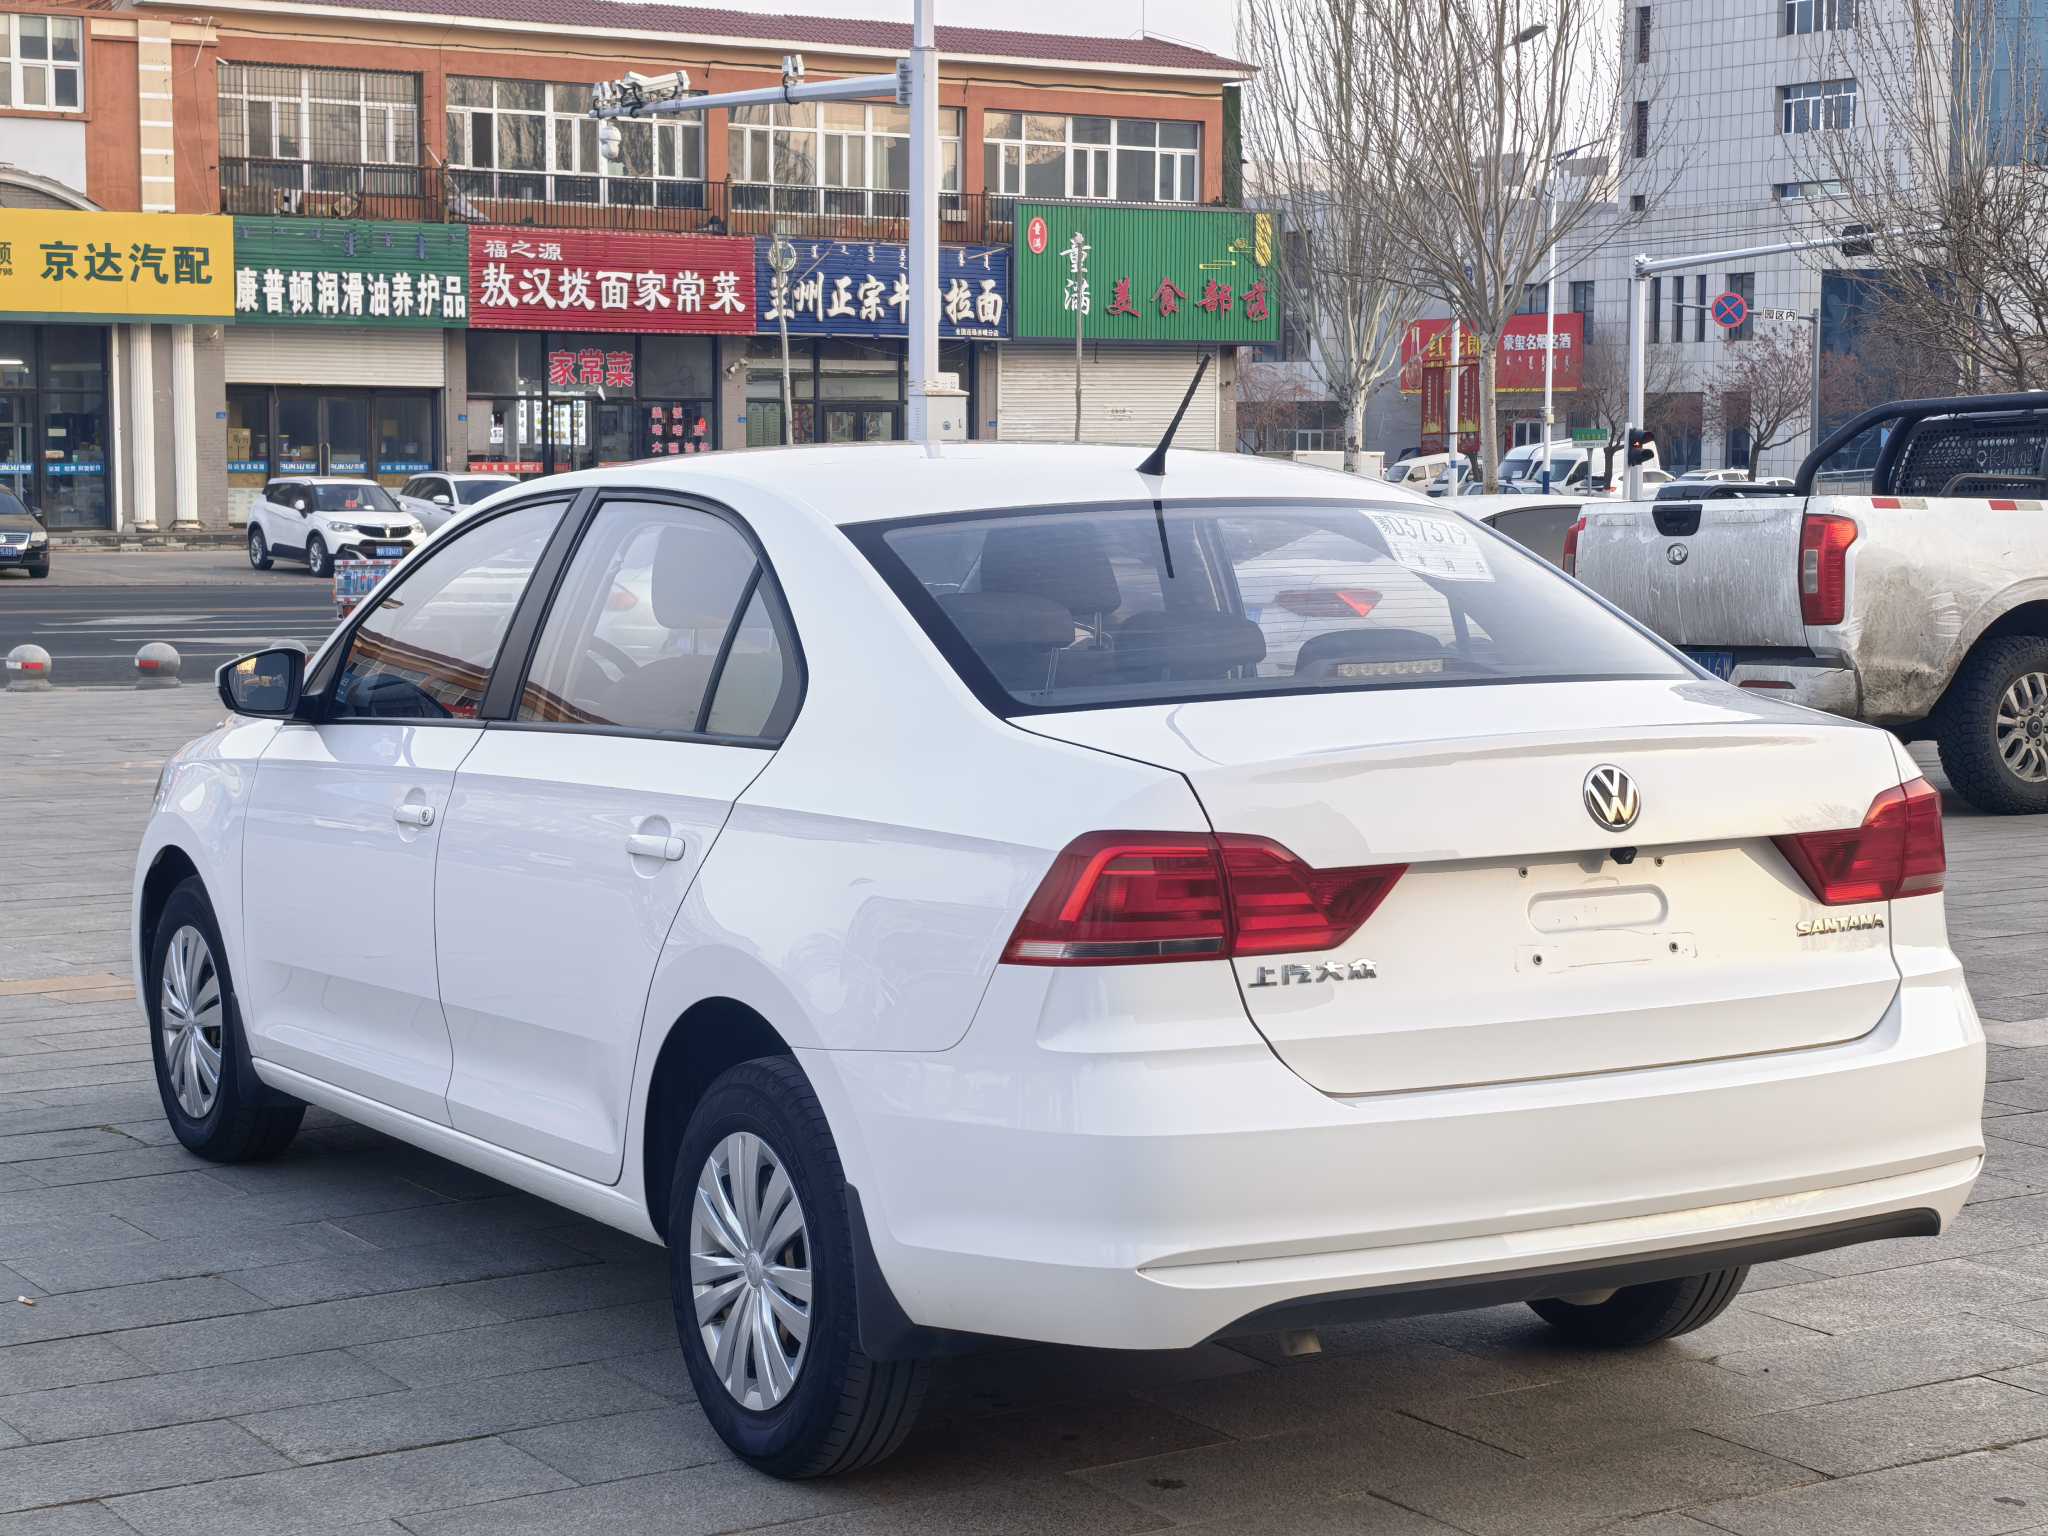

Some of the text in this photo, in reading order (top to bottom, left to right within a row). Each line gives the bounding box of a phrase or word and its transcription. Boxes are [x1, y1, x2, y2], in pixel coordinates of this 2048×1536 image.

[39, 241, 213, 284] 京达汽配
[483, 240, 563, 261] 福之源
[236, 266, 466, 318] 康普顿润滑油养护品
[479, 263, 746, 314] 敖汉拨面家常菜
[764, 272, 1003, 326] 兰州正宗牛拉面
[1105, 275, 1269, 323] 美食部落
[548, 348, 634, 388] 家常菜
[1796, 913, 1885, 937] SANTANA
[1248, 958, 1377, 988] 上汽大众
